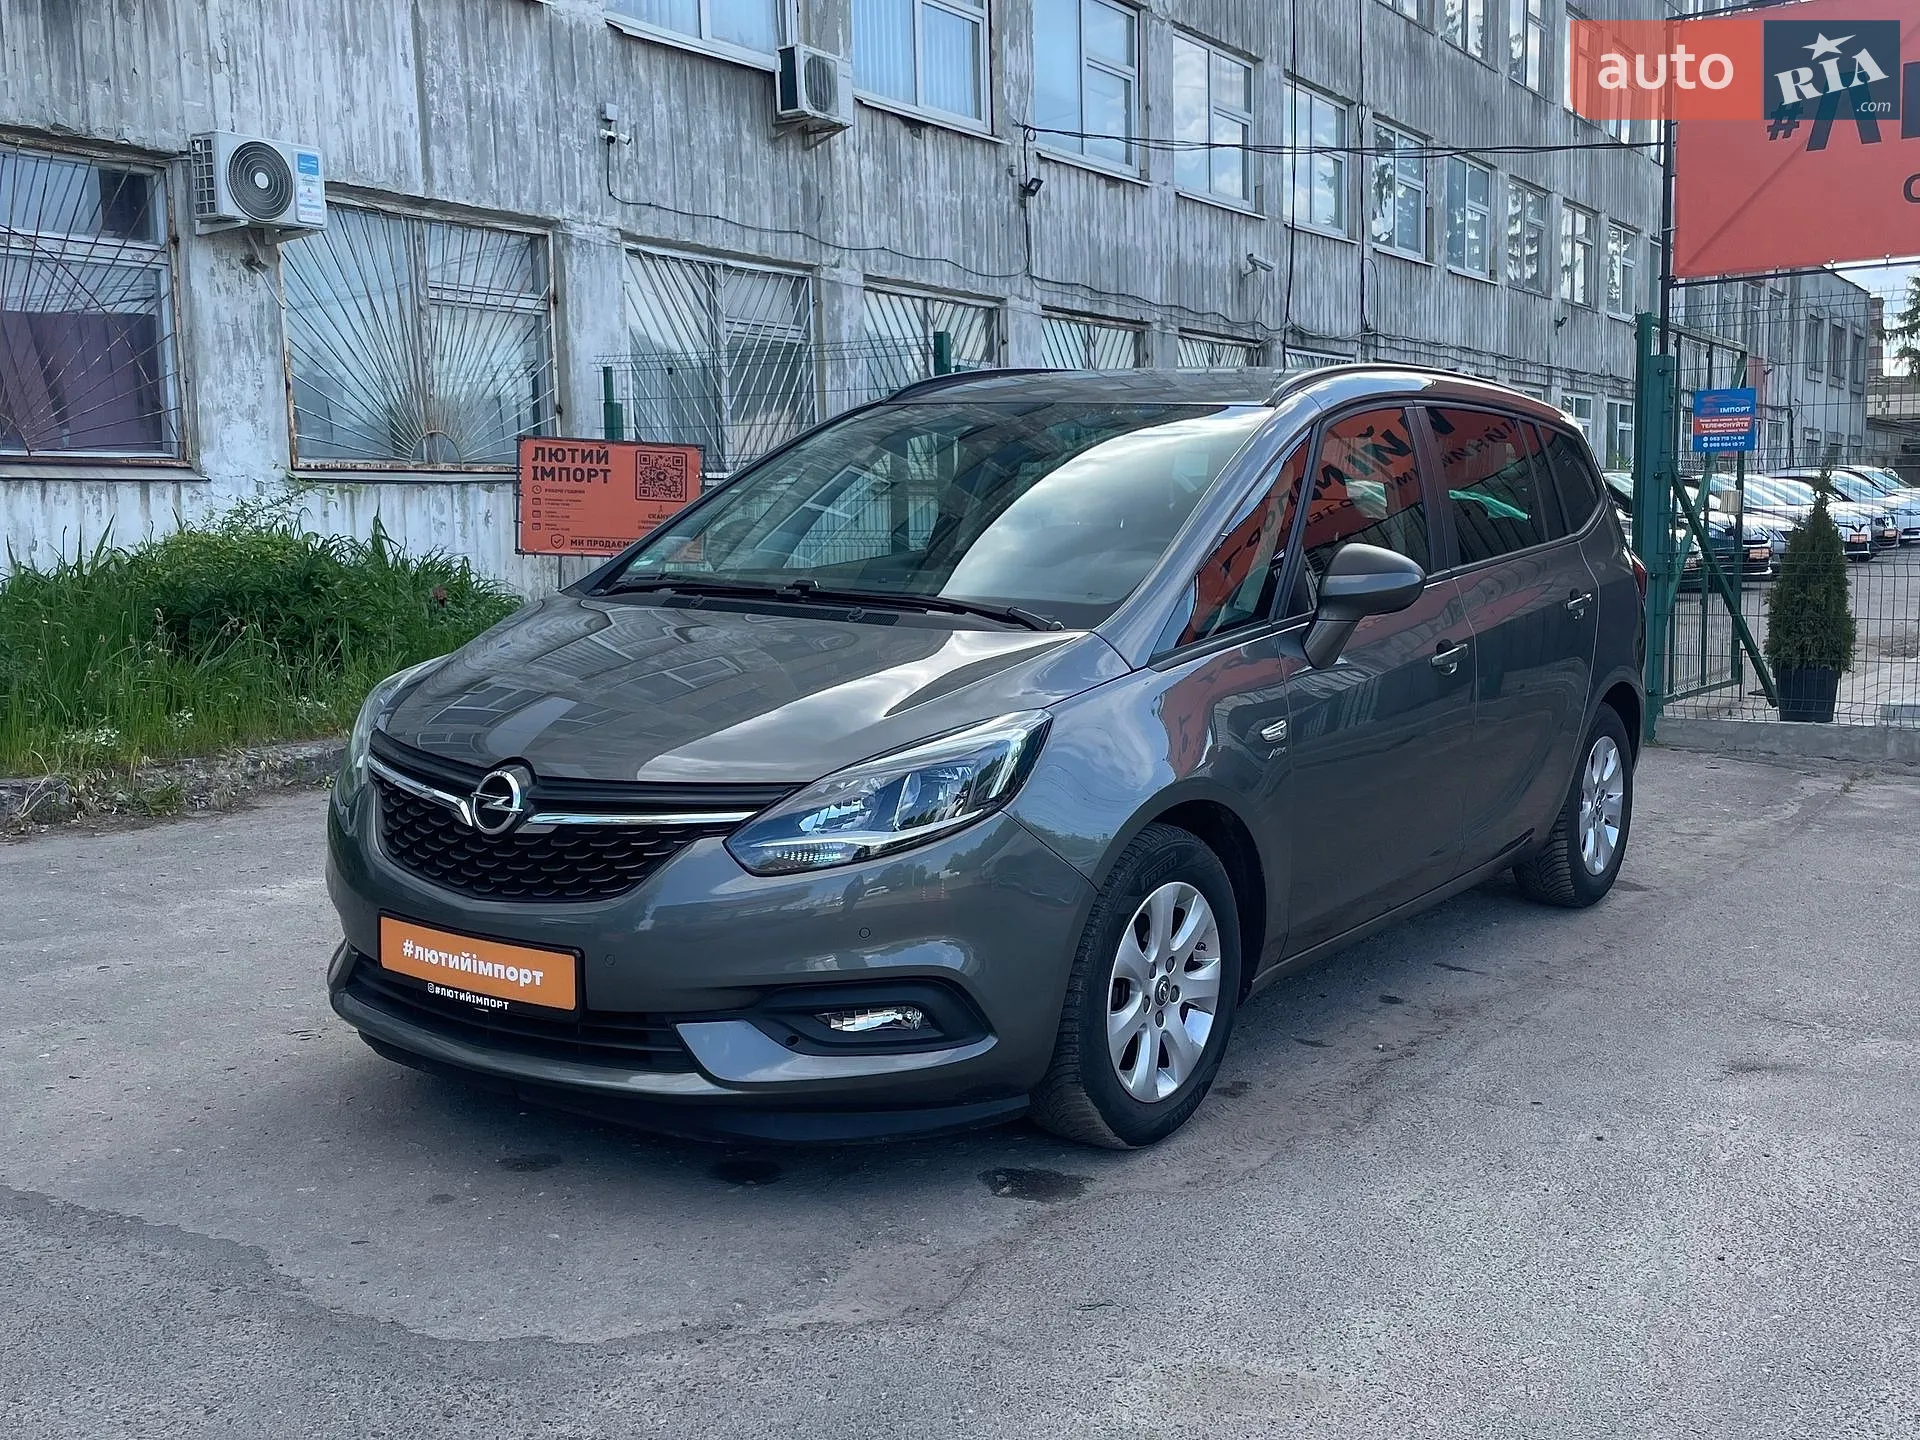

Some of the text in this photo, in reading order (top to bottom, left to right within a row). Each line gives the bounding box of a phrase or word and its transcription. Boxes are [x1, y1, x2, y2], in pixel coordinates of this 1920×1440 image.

[1701, 421, 1749, 429] ТЕЛЕФОНУЙТЕ
[532, 446, 609, 465] ЛЮТИЙ
[532, 466, 611, 484] ІМПОРТ
[570, 539, 584, 547] МИ
[402, 939, 543, 987] #лютийімпорт
[434, 986, 509, 1011] #ЛЮТИЙІМПОРТ
